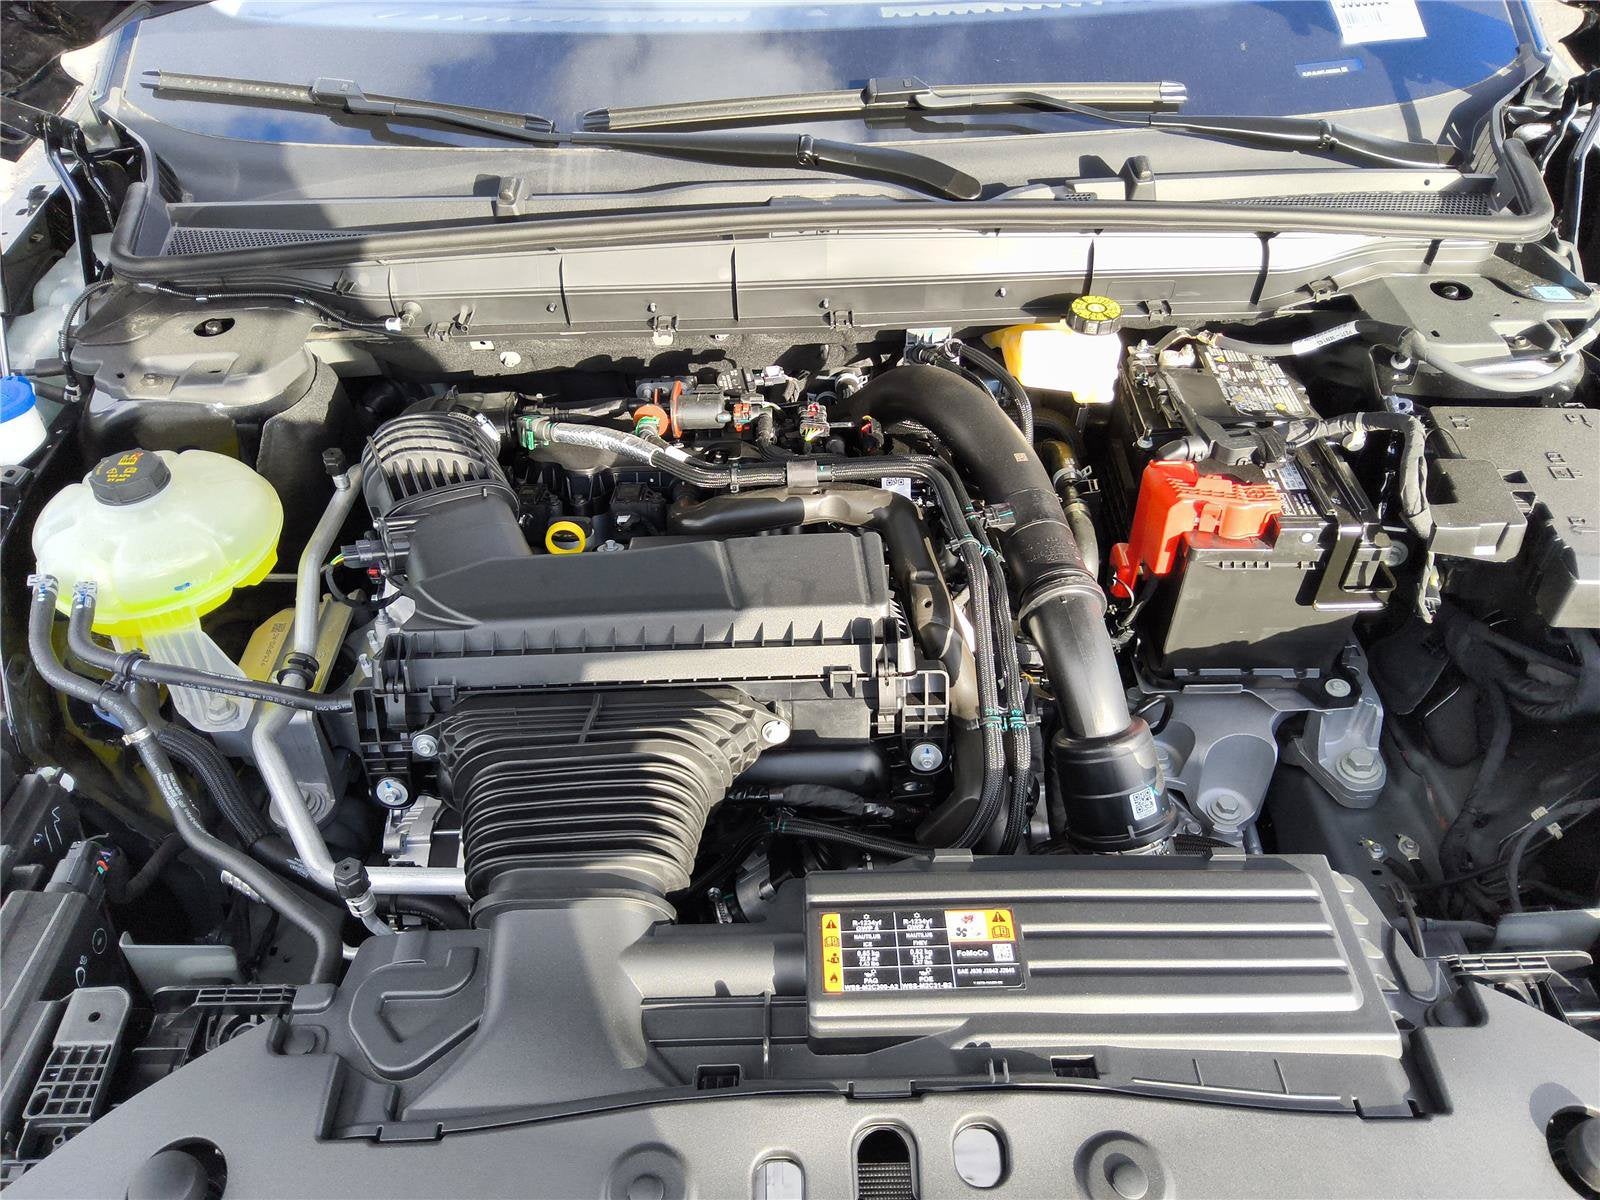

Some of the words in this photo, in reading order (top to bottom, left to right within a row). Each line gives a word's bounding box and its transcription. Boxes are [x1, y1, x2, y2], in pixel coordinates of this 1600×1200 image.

[852, 919, 882, 927] R-1234yf
[903, 918, 933, 926] R-1234yf
[871, 950, 880, 958] kg
[924, 948, 933, 957] kg
[956, 949, 989, 957] FoMoCo
